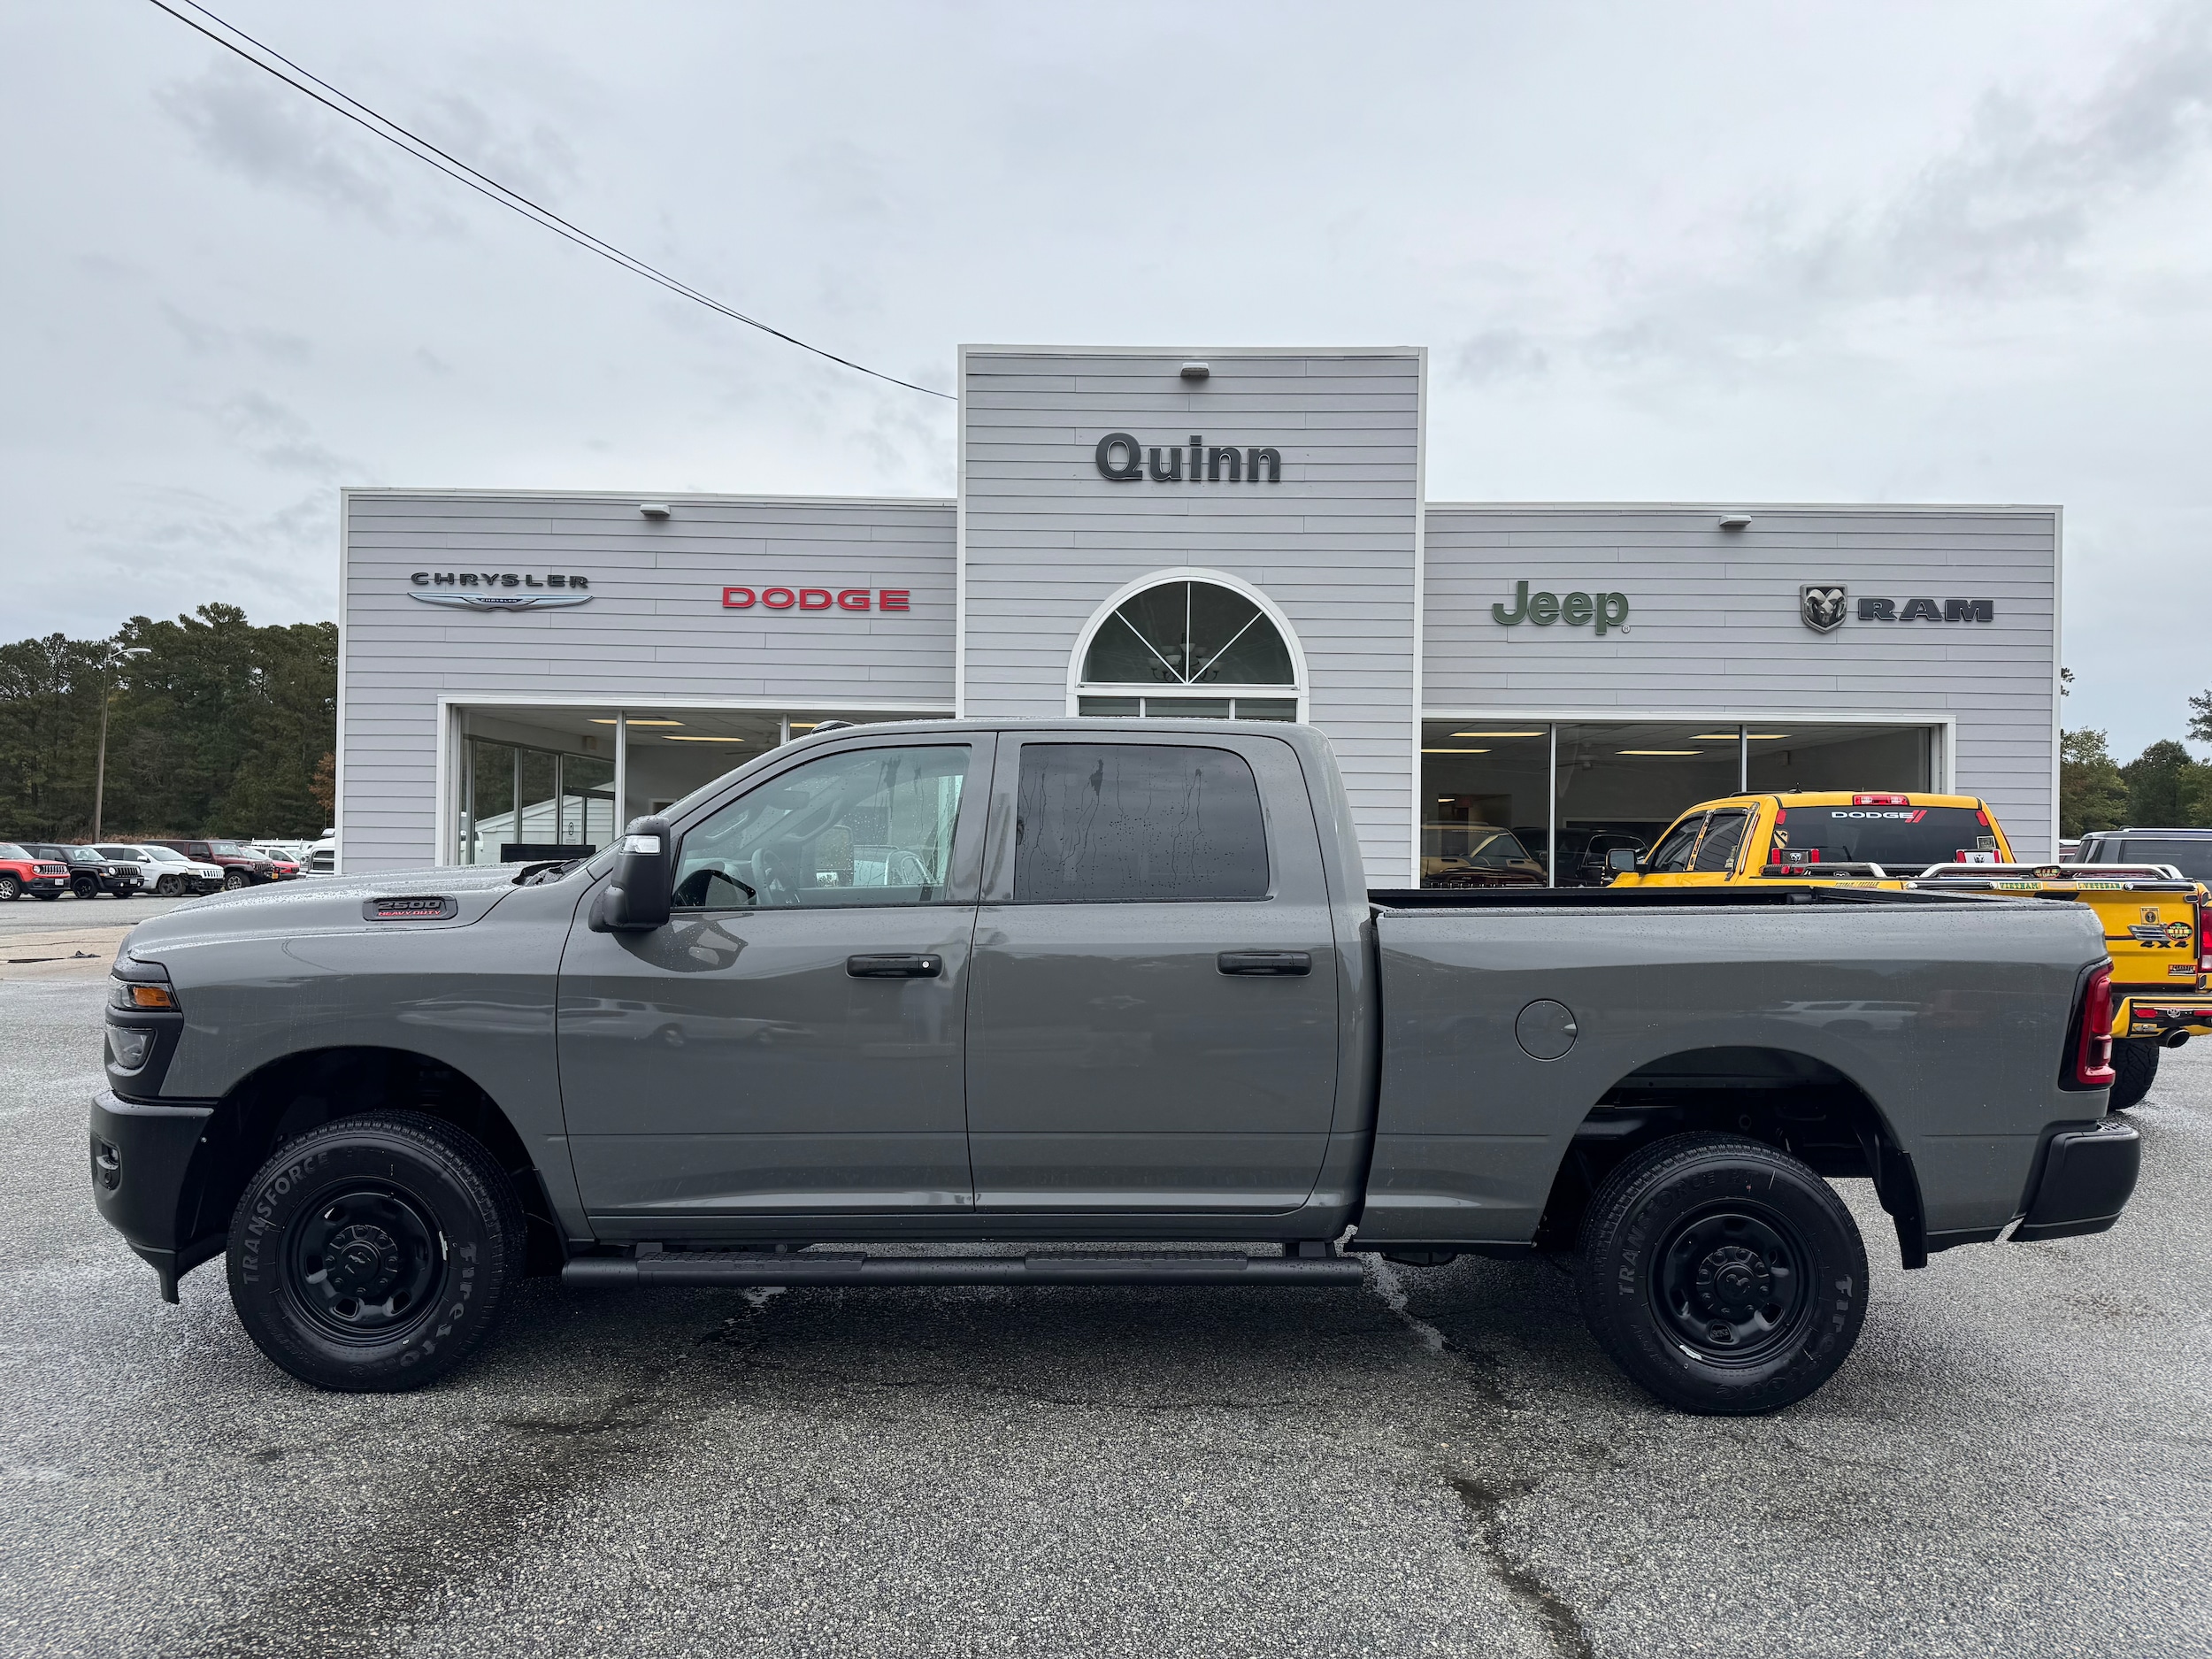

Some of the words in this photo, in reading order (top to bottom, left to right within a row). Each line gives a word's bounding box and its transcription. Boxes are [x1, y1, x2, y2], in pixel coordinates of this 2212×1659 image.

[1095, 432, 1282, 482] Quinn
[411, 572, 589, 588] CHRYSLER
[722, 587, 910, 611] DODGE
[1492, 580, 1629, 635] Jeep
[1857, 597, 1994, 622] RAM
[1831, 810, 1915, 819] DODGE
[378, 901, 442, 910] 2500
[242, 1151, 330, 1285] TRANSFORCE
[1618, 1170, 1716, 1296] TRANSFORCE
